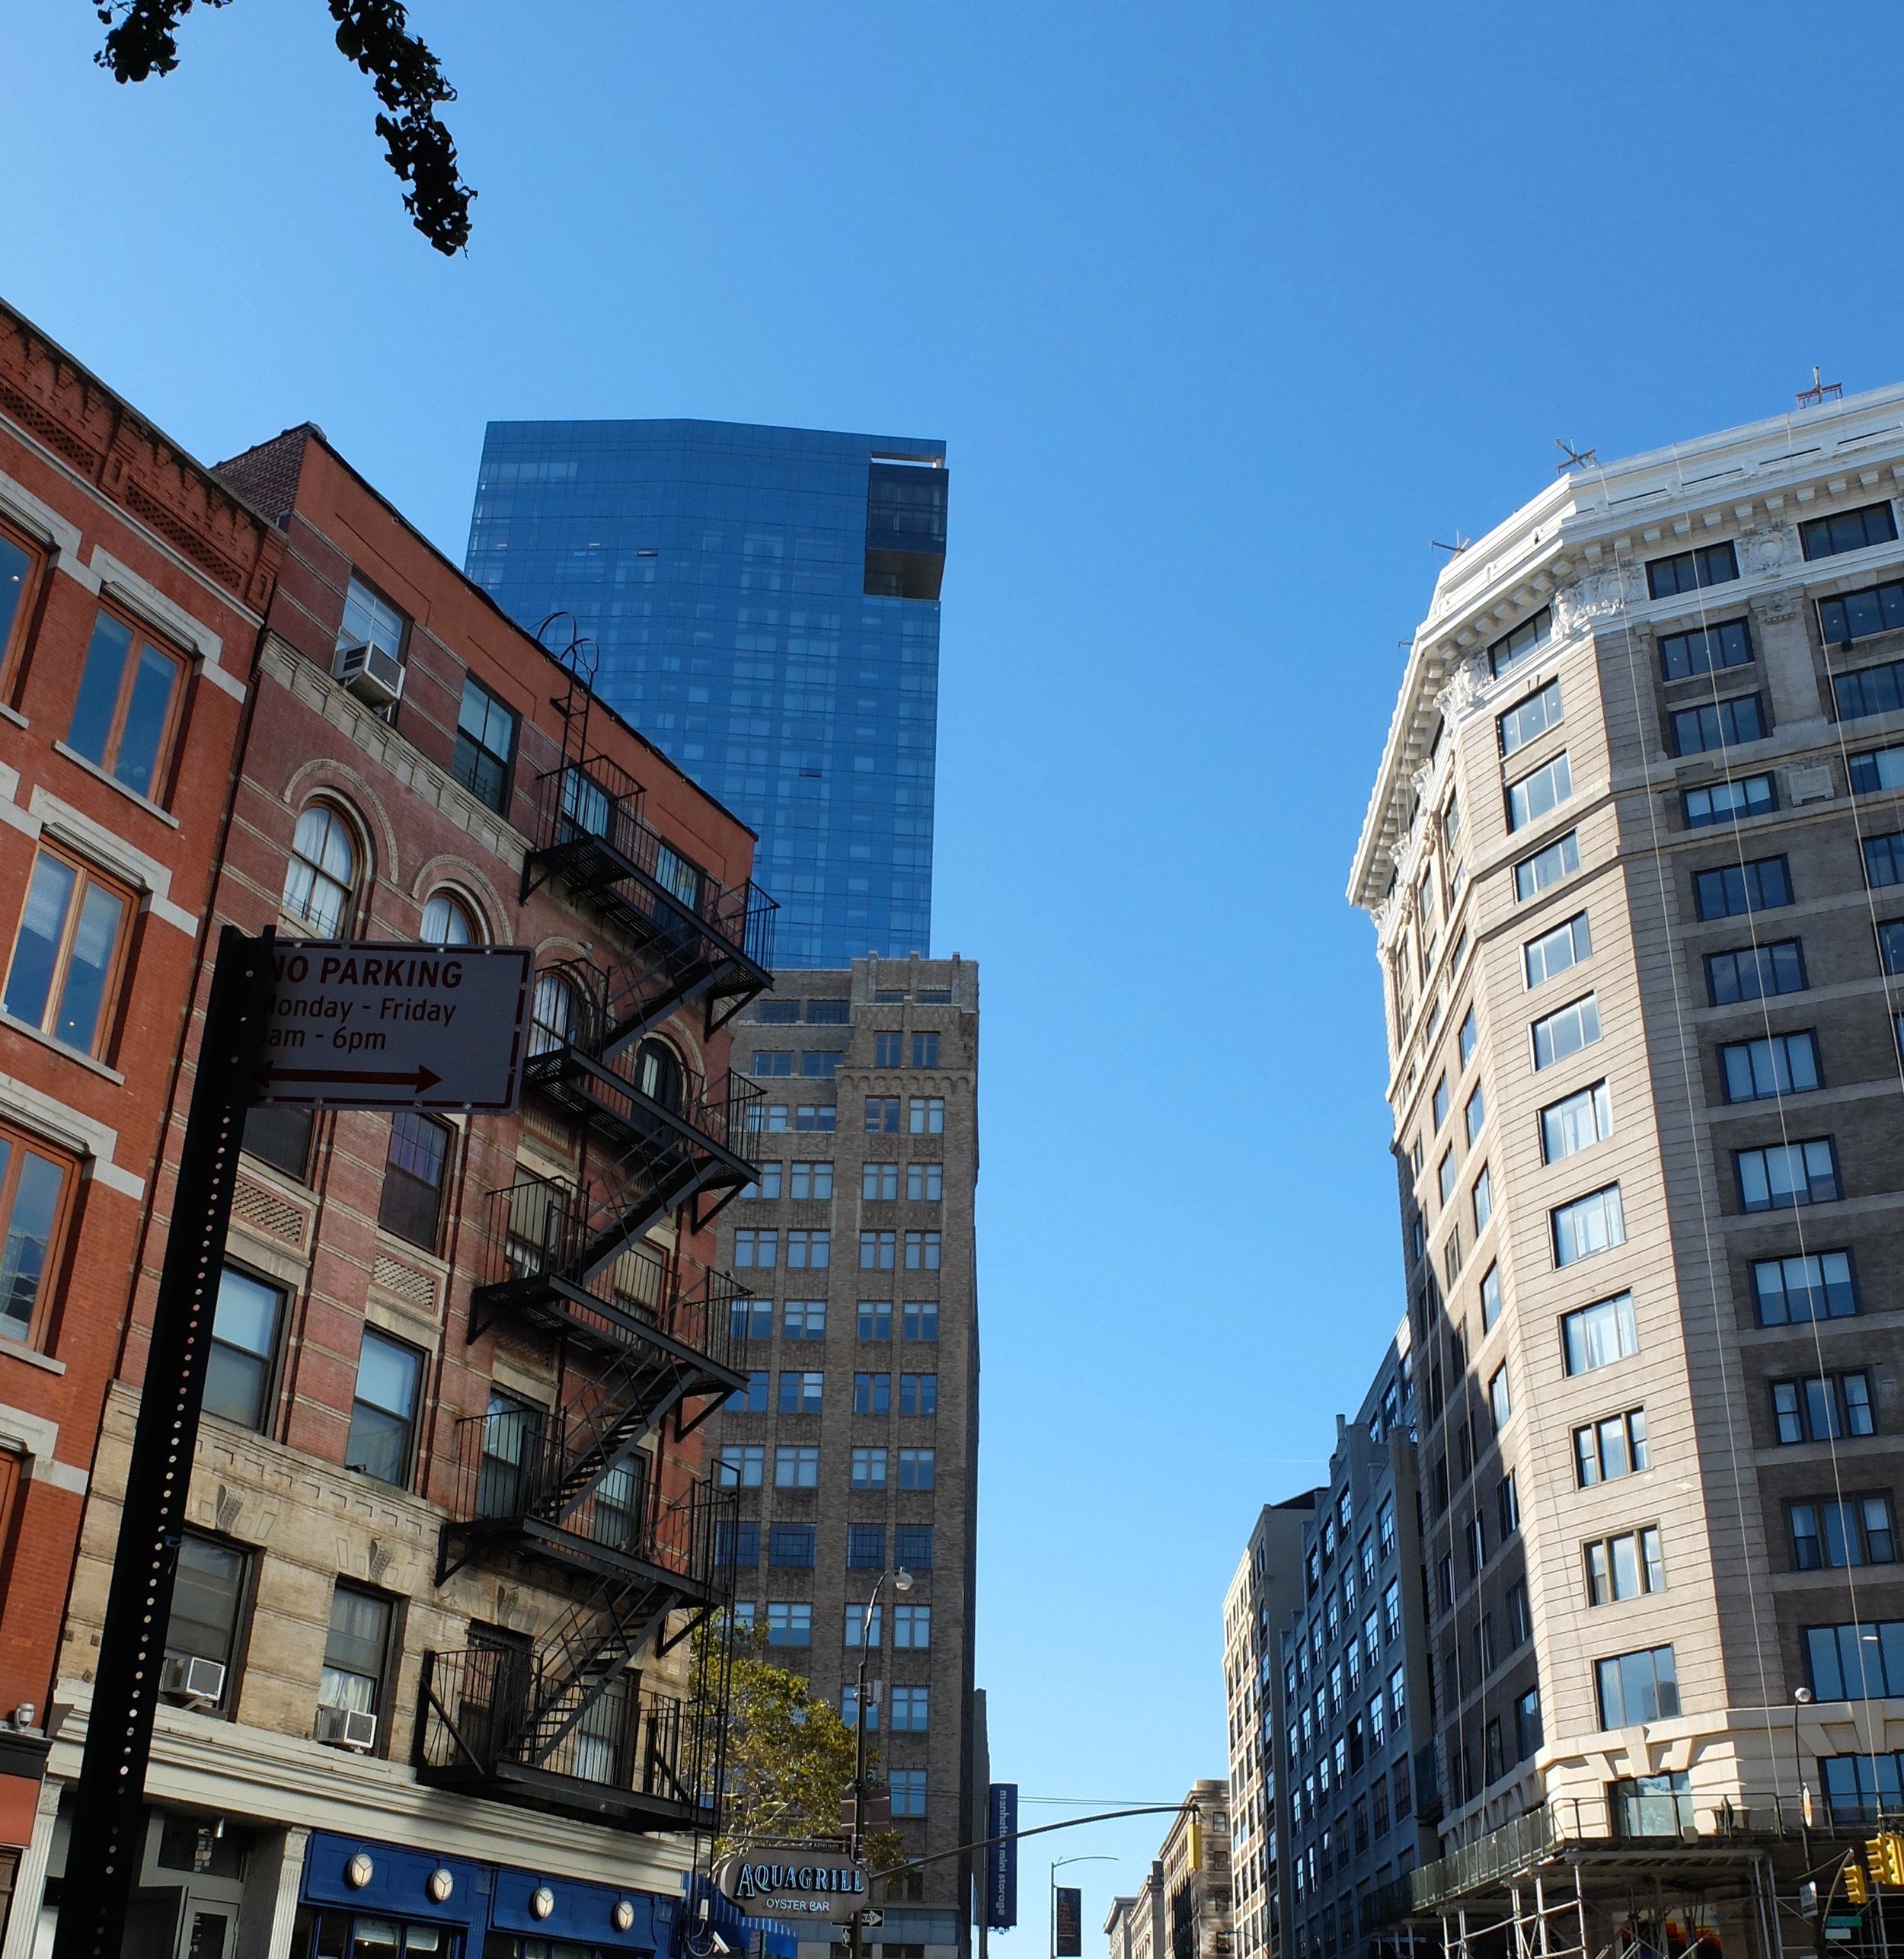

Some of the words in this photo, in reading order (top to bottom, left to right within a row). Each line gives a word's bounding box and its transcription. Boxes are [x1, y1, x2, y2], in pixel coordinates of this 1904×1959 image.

[320, 957, 463, 989] PARKING
[380, 998, 457, 1027] Friday
[265, 1027, 306, 1047] am
[333, 1026, 387, 1054] 6pm
[999, 1849, 1008, 1872] mini
[736, 1863, 865, 1897] AQUAGRILL
[766, 1898, 807, 1911] OYSTER
[809, 1901, 830, 1913] BAR
[995, 1874, 1006, 1916] storage
